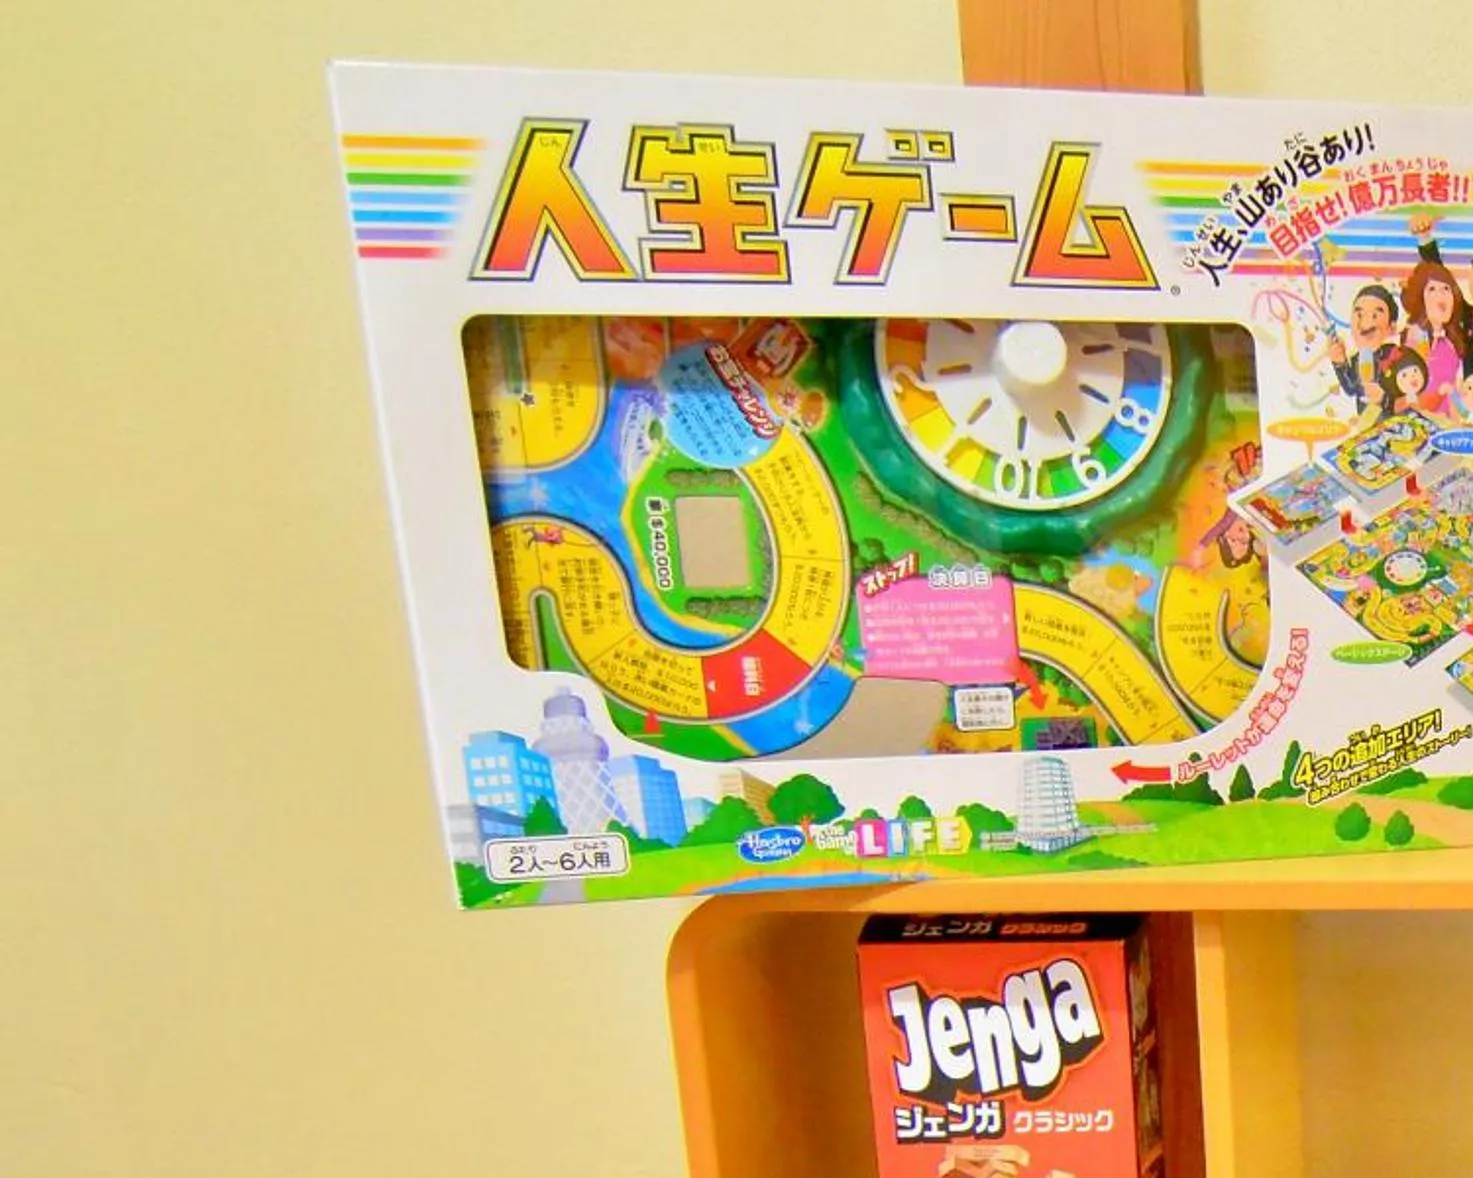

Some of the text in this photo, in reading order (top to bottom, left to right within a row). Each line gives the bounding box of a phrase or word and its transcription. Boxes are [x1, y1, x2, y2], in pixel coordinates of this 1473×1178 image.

[468, 117, 1162, 290] 人生ゲーム
[860, 818, 963, 857] LIFE
[888, 957, 1104, 1095] Jenga
[895, 1101, 1115, 1140] ジェンガ クラシック
